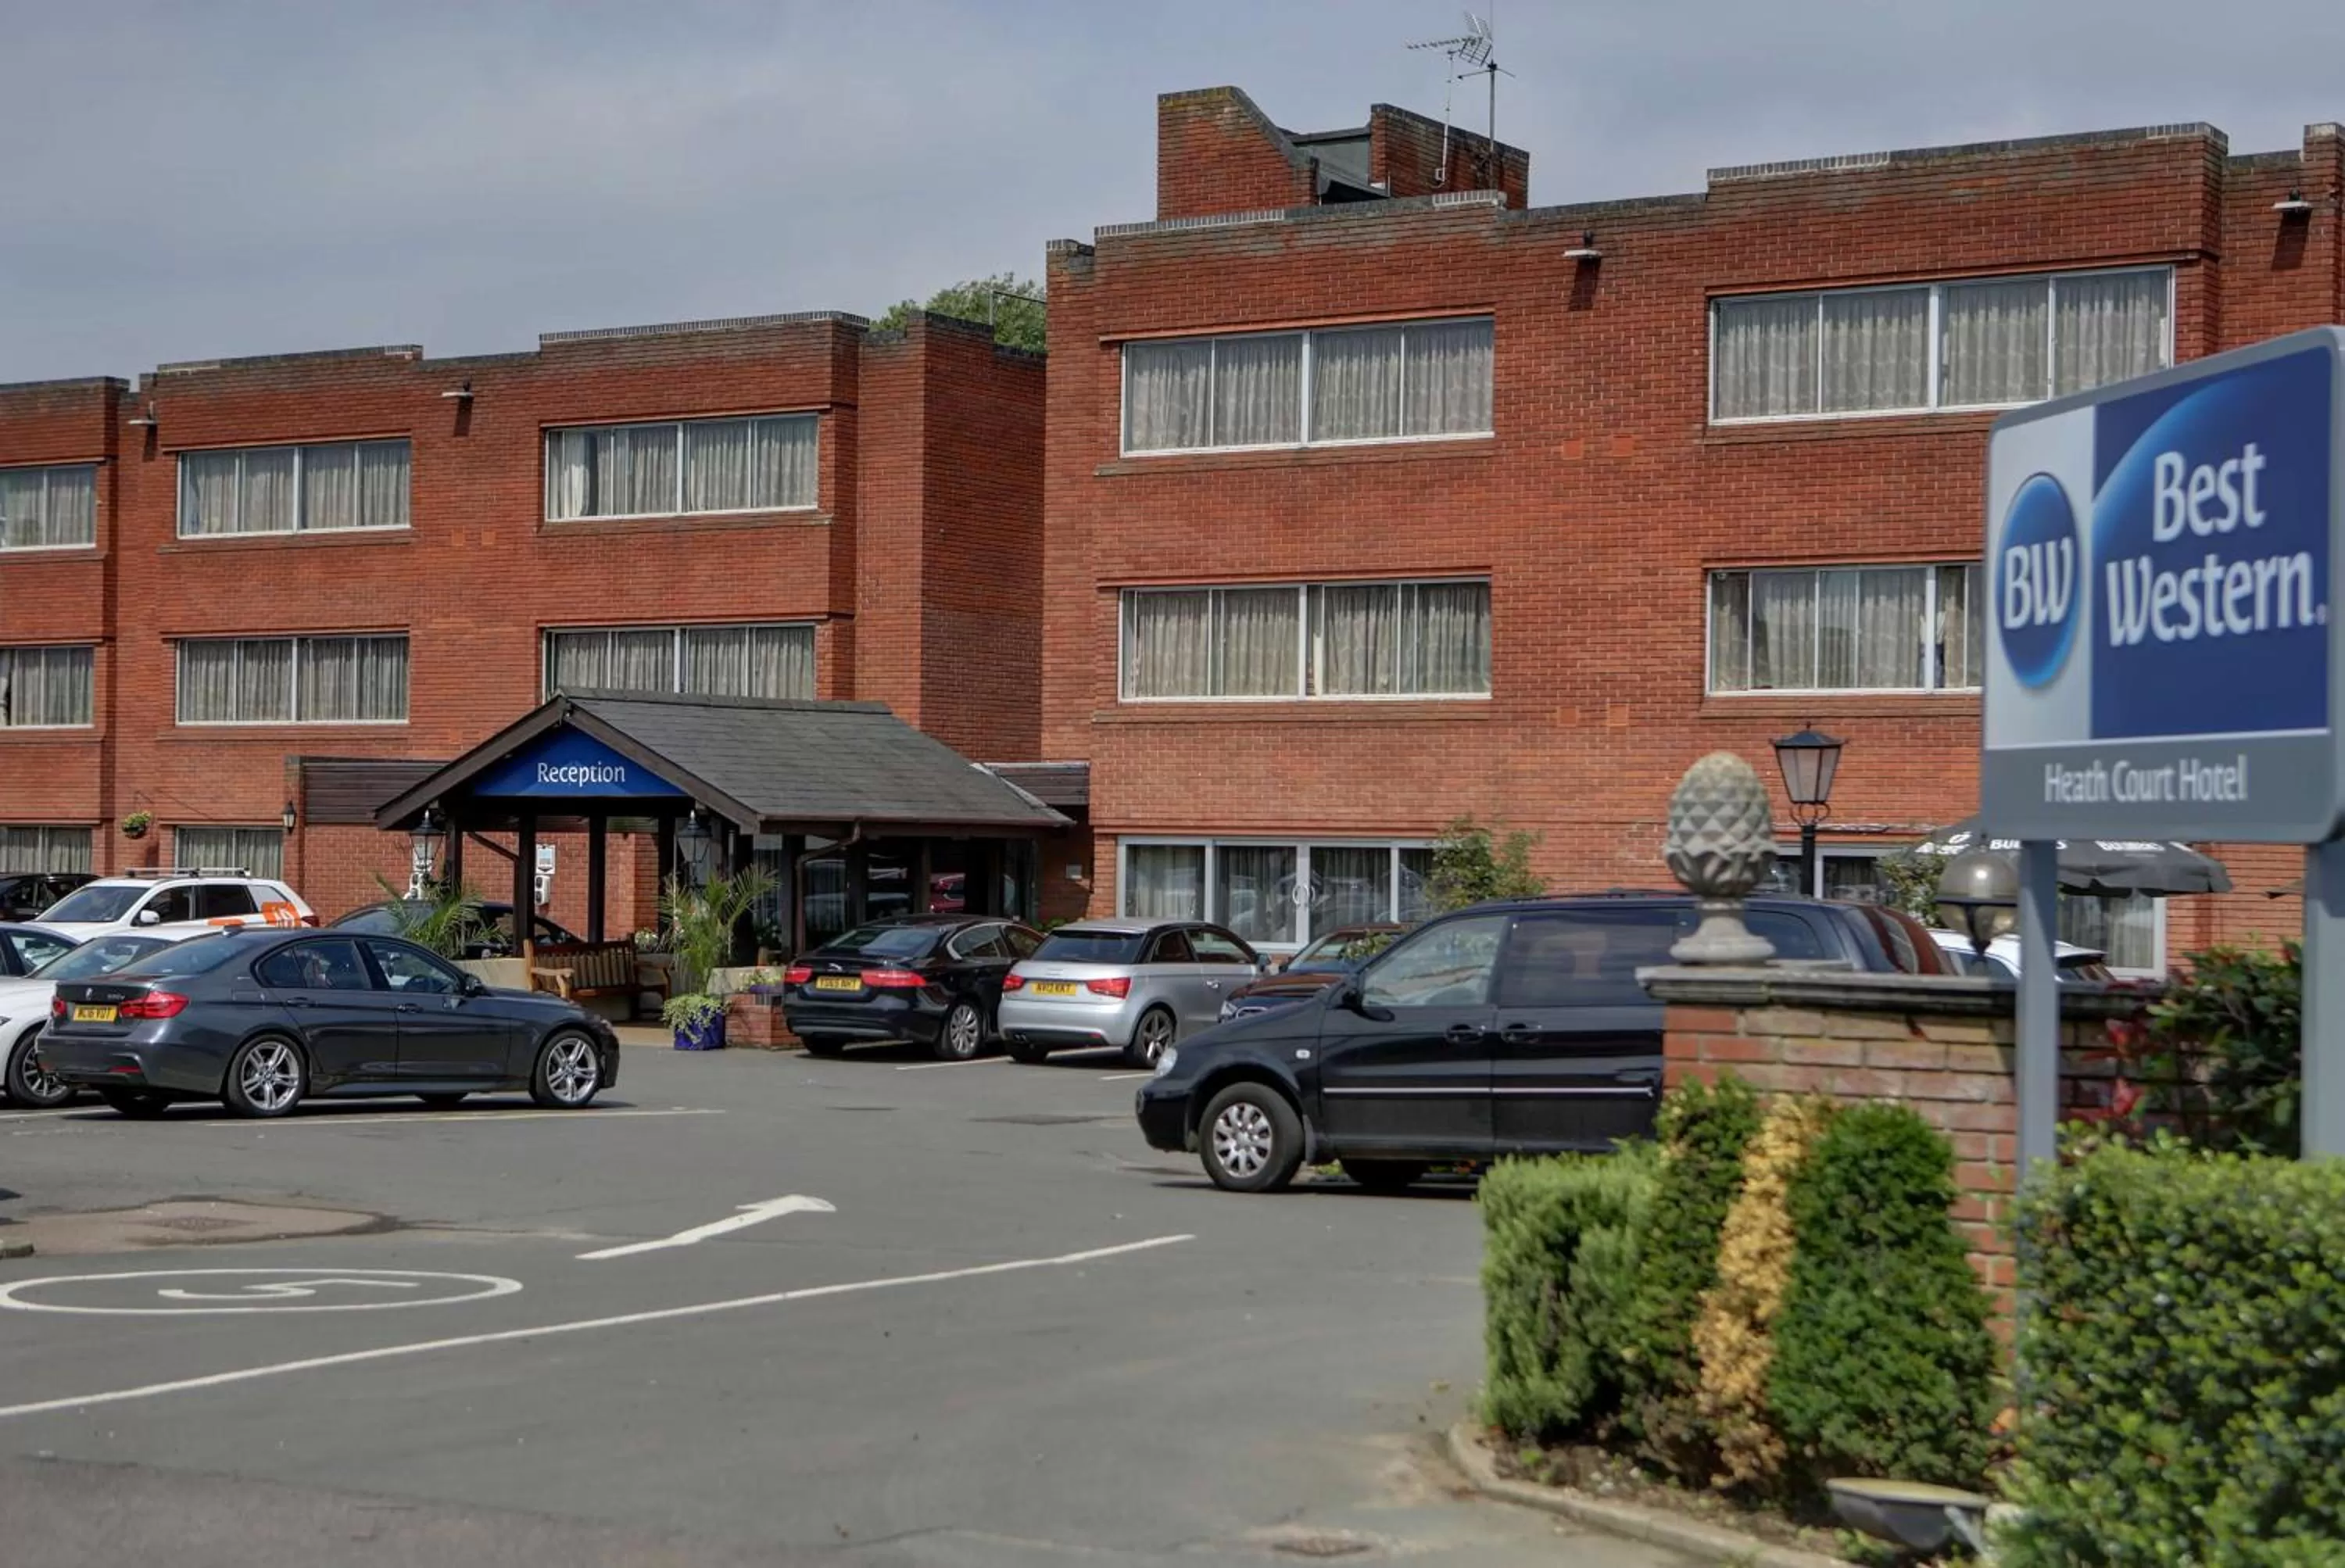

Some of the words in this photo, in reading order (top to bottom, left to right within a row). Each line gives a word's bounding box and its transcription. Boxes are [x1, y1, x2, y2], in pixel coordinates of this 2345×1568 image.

[2153, 442, 2265, 542] Best
[2003, 537, 2073, 630] BW
[537, 761, 625, 787] Reception
[2044, 761, 2109, 803] Heath
[2112, 759, 2174, 802] Court
[2179, 755, 2248, 801] Hotel
[1989, 839, 2068, 851] BULS
